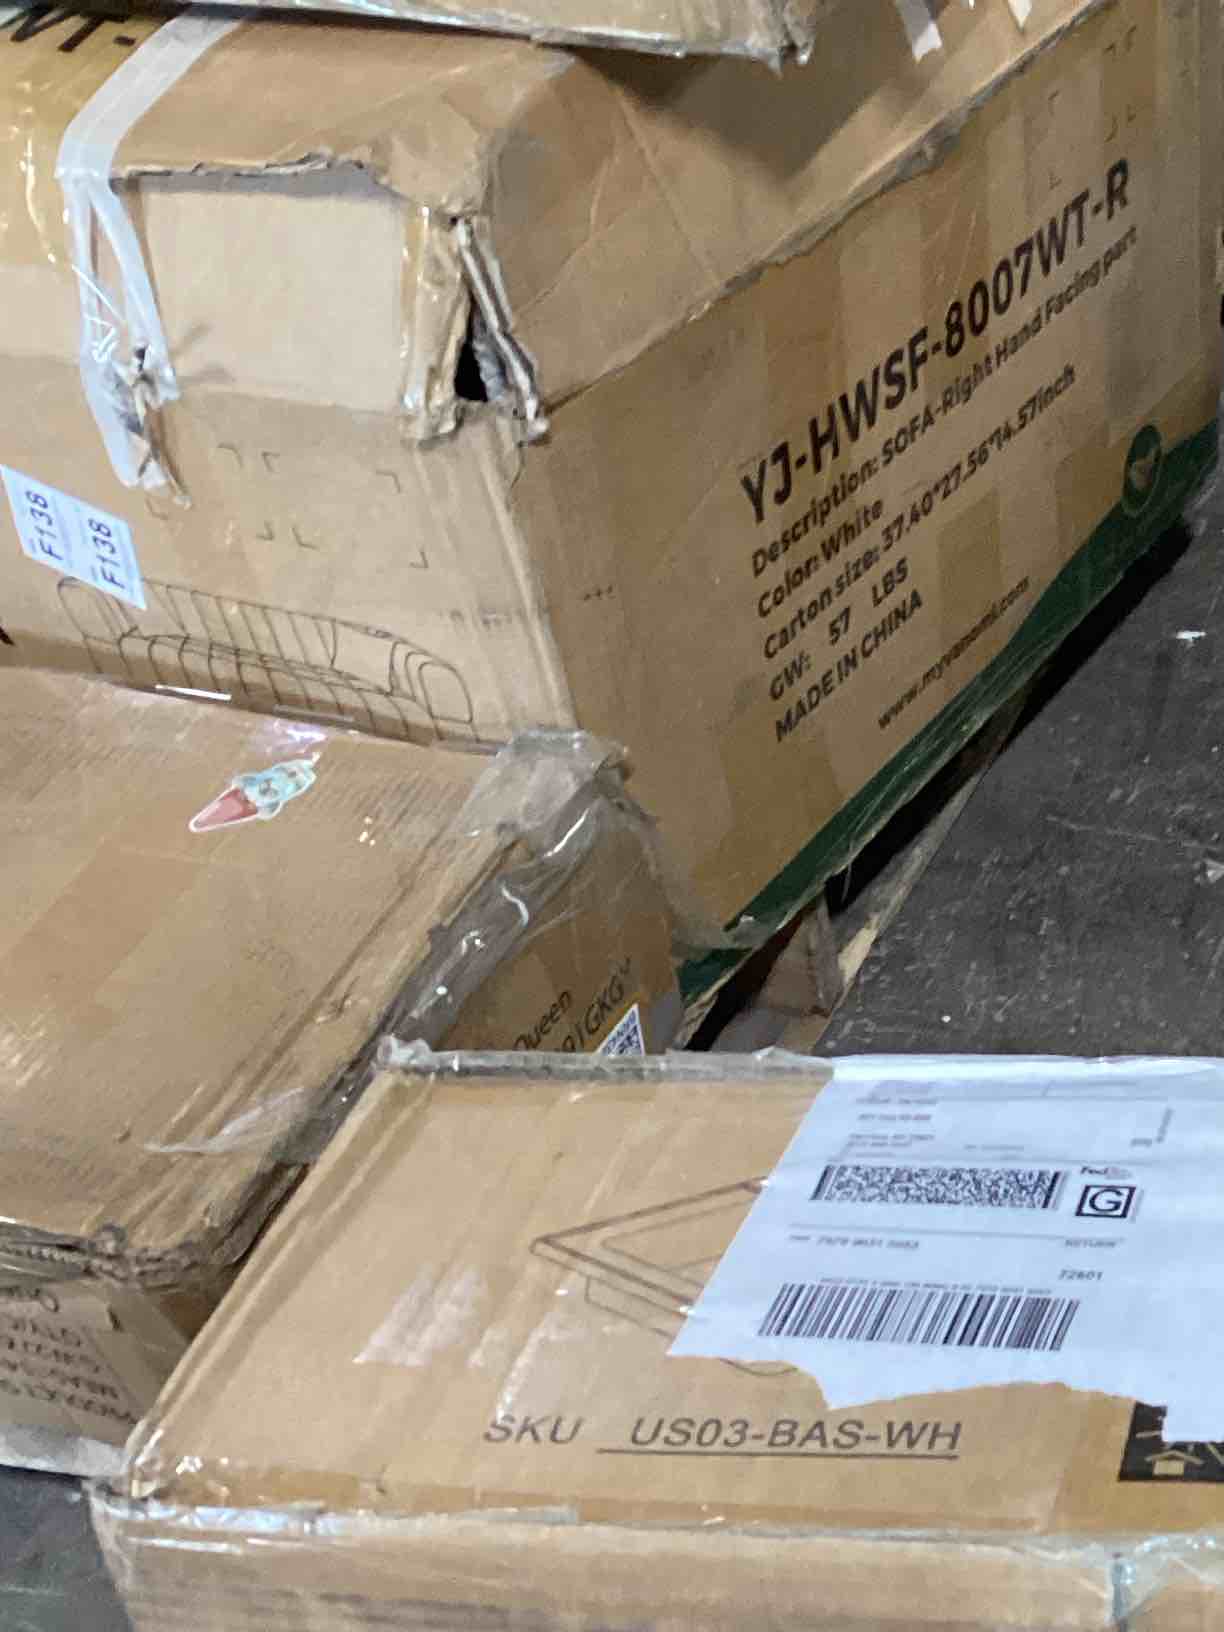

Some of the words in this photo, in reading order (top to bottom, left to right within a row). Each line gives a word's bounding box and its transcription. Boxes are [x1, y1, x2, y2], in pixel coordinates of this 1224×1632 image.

[740, 158, 1130, 524] YJ-HWSF-8007WT-R
[752, 457, 878, 578] Description:
[882, 353, 993, 466] SOFA-Right
[996, 306, 1042, 368] Hand
[1045, 259, 1100, 324] Facing
[25, 491, 63, 560] F138
[88, 518, 125, 588] F138
[758, 555, 819, 618] Color:
[821, 500, 884, 564] White
[764, 586, 832, 659] Carton
[835, 546, 880, 599] size:
[769, 653, 812, 701] GW:
[829, 606, 851, 646] 57
[872, 556, 909, 608] LBS
[775, 670, 834, 743] MADE
[835, 646, 858, 684] IN
[860, 589, 923, 659] CHINA
[1089, 1188, 1122, 1211] G
[483, 1414, 584, 1445] SKU
[630, 1416, 961, 1450] US03-BAS-WH
